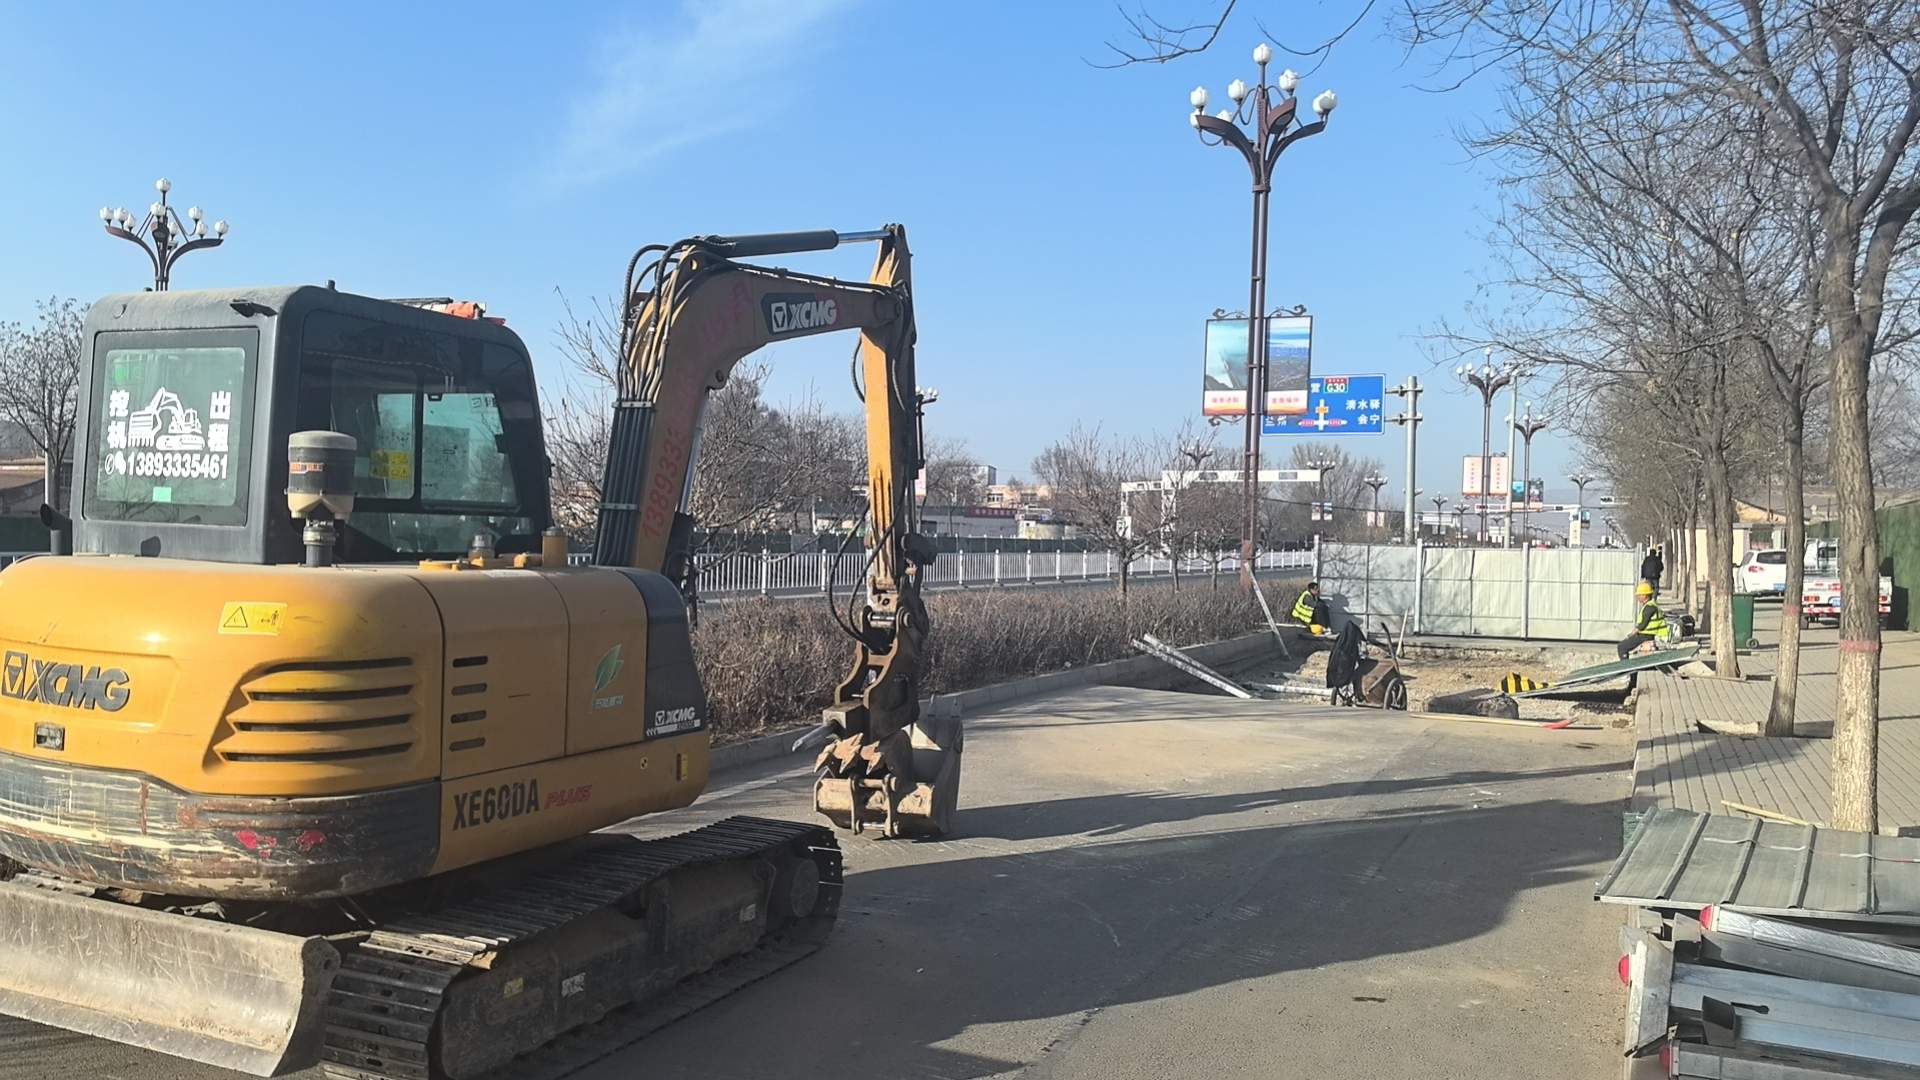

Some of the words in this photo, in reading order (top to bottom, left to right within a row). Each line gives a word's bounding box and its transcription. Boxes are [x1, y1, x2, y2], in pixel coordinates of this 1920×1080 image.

[789, 299, 837, 329] XCMG
[1326, 383, 1346, 393] G30
[1357, 414, 1380, 425] 会宁
[126, 451, 228, 479] 13893335461
[25, 659, 131, 712] XCMG
[665, 706, 696, 724] XCMG
[452, 777, 541, 832] XE60DA
